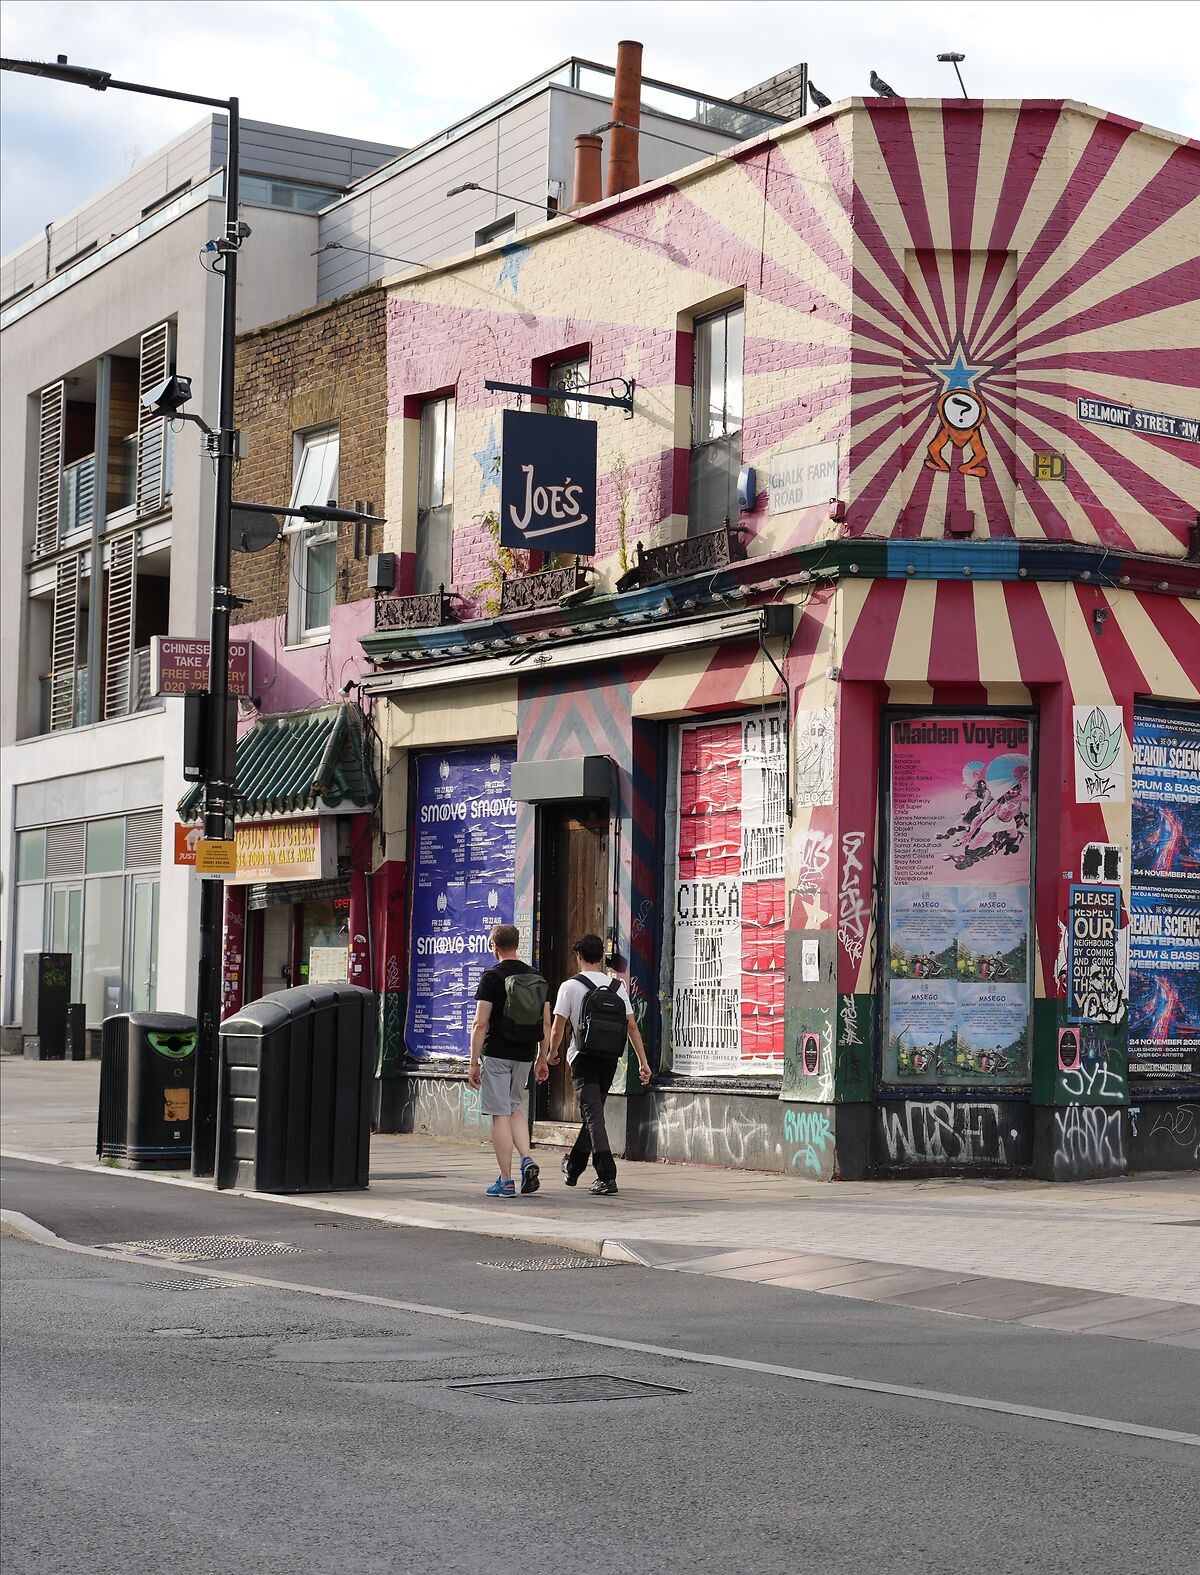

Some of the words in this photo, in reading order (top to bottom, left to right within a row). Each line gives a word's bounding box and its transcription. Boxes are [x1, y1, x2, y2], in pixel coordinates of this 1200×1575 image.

[1080, 402, 1131, 426] BELMONT
[771, 466, 803, 489] CHALK
[807, 459, 836, 481] FARM
[774, 488, 802, 508] ROAD
[162, 643, 210, 655] CHINESE
[174, 656, 202, 667] TAKE
[162, 669, 189, 679] FREE
[195, 670, 246, 681] DEERY
[164, 681, 185, 692] 020
[1134, 715, 1167, 724] CELEBRATING
[894, 723, 959, 744] Maiden
[963, 723, 1028, 749] Voyage
[1133, 744, 1167, 767] REAKIN
[1132, 780, 1162, 790] DRUM
[1164, 783, 1173, 791] &
[268, 822, 315, 848] KITCHEN
[278, 848, 295, 864] TAKE
[297, 847, 315, 863] AWAY
[1145, 870, 1186, 878] NOVEMBER
[677, 882, 739, 918] CIRCA
[1074, 893, 1115, 906] PLEASE
[1074, 909, 1114, 917] RESPECT
[1074, 917, 1115, 939] OUR
[1129, 914, 1162, 935] REAKIN
[1074, 939, 1114, 947] NEIGHBOURS
[1074, 948, 1083, 957] BY
[1086, 948, 1114, 957] COMING
[1160, 951, 1168, 959] &
[1171, 951, 1199, 960] BASS
[1074, 958, 1089, 966] AND
[1092, 957, 1114, 966] GOING
[1129, 960, 1199, 970] WEEKENDER
